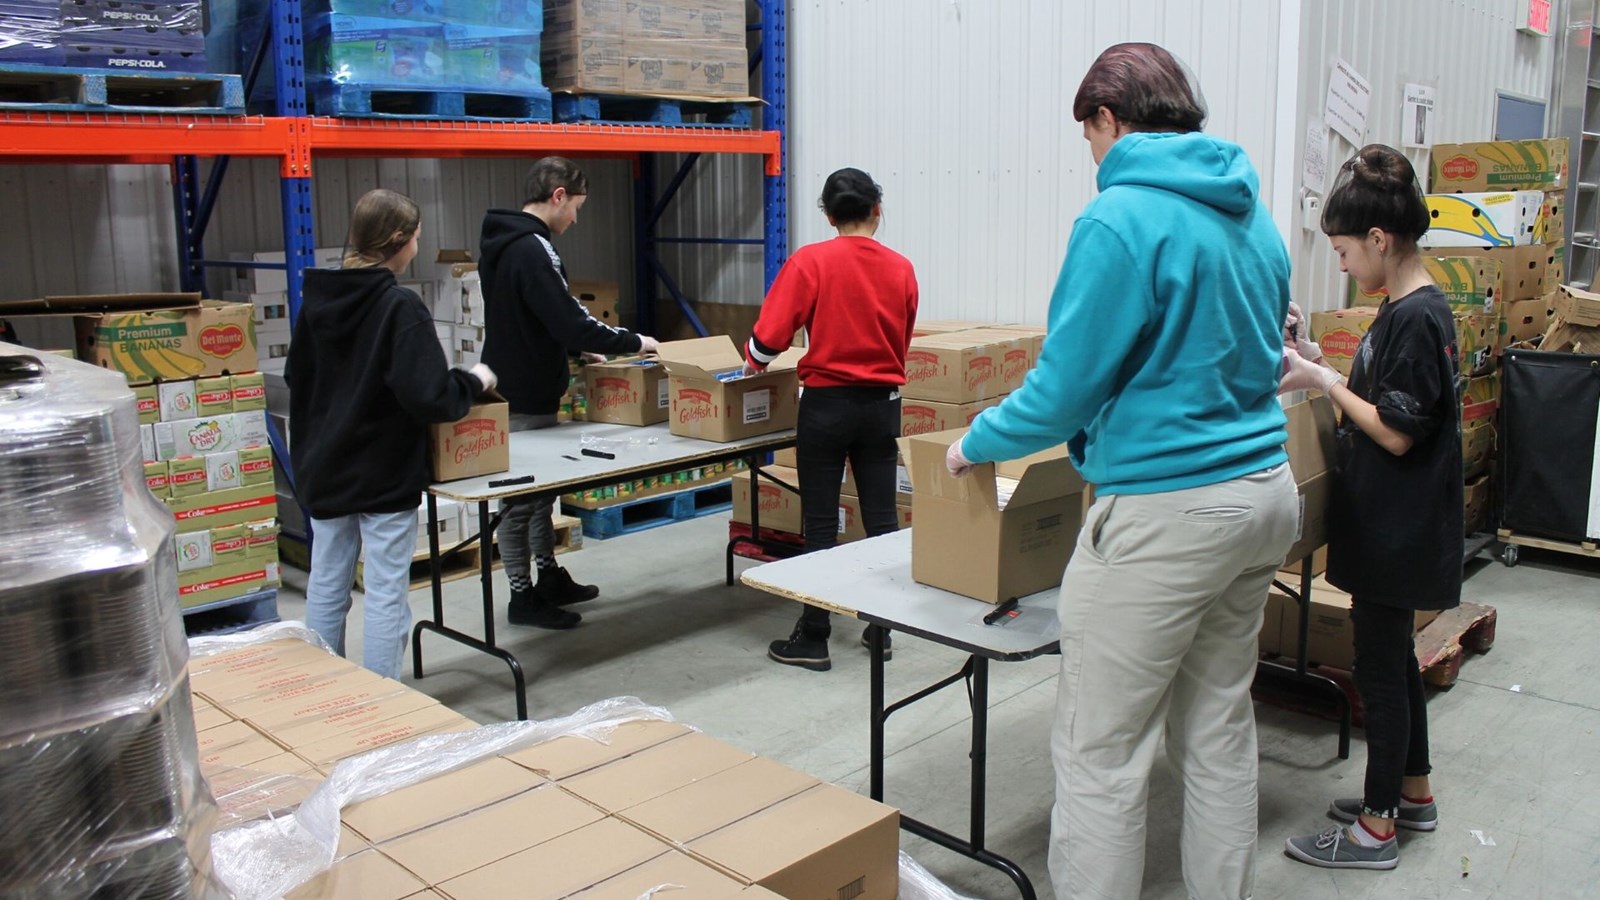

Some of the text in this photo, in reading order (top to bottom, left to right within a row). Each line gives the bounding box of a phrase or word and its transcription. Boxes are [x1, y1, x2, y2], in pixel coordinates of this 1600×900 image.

[1492, 163, 1542, 172] BANANAS
[1499, 174, 1542, 182] Premium
[118, 326, 172, 340] Premium
[202, 334, 242, 346] Del Monte
[120, 338, 182, 353] BANANAS
[1322, 340, 1346, 350] Monte
[905, 364, 938, 384] Goldfish
[1004, 360, 1026, 384] Goldfish
[968, 369, 992, 392] Goldfish
[597, 390, 632, 410] Goldfish
[680, 404, 712, 424] Goldfish
[902, 419, 936, 438] Goldfish
[190, 428, 222, 445] CANADA
[200, 437, 217, 448] DRY
[454, 432, 496, 464] Goldfish
[187, 508, 206, 518] Coke
[192, 584, 210, 593] Coke
